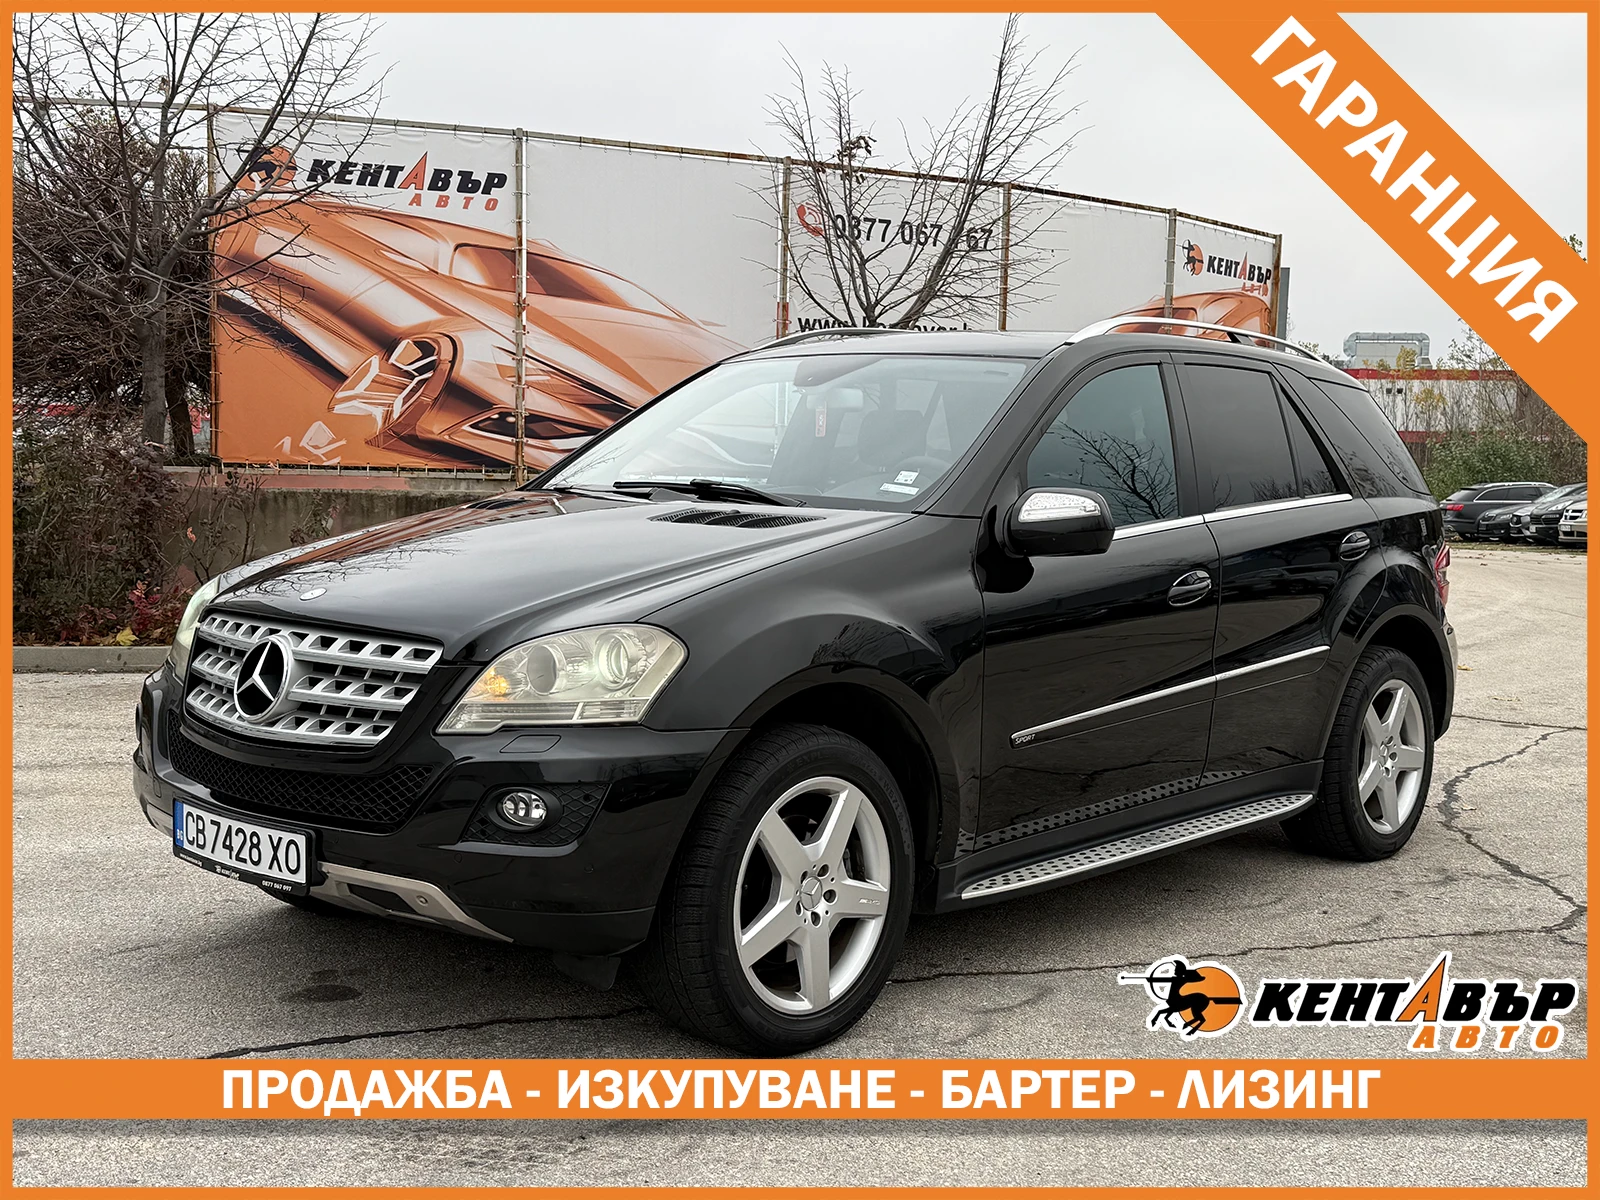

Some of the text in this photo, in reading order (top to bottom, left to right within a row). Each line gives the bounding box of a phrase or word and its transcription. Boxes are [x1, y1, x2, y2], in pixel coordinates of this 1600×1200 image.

[306, 151, 507, 195] КЕНТАВЪР
[408, 193, 499, 212] АВТО
[901, 221, 943, 248] 067
[1206, 251, 1272, 285] КЕНТАВЪР
[1015, 733, 1036, 745] SPORT
[185, 810, 301, 875] CB 7428 XO
